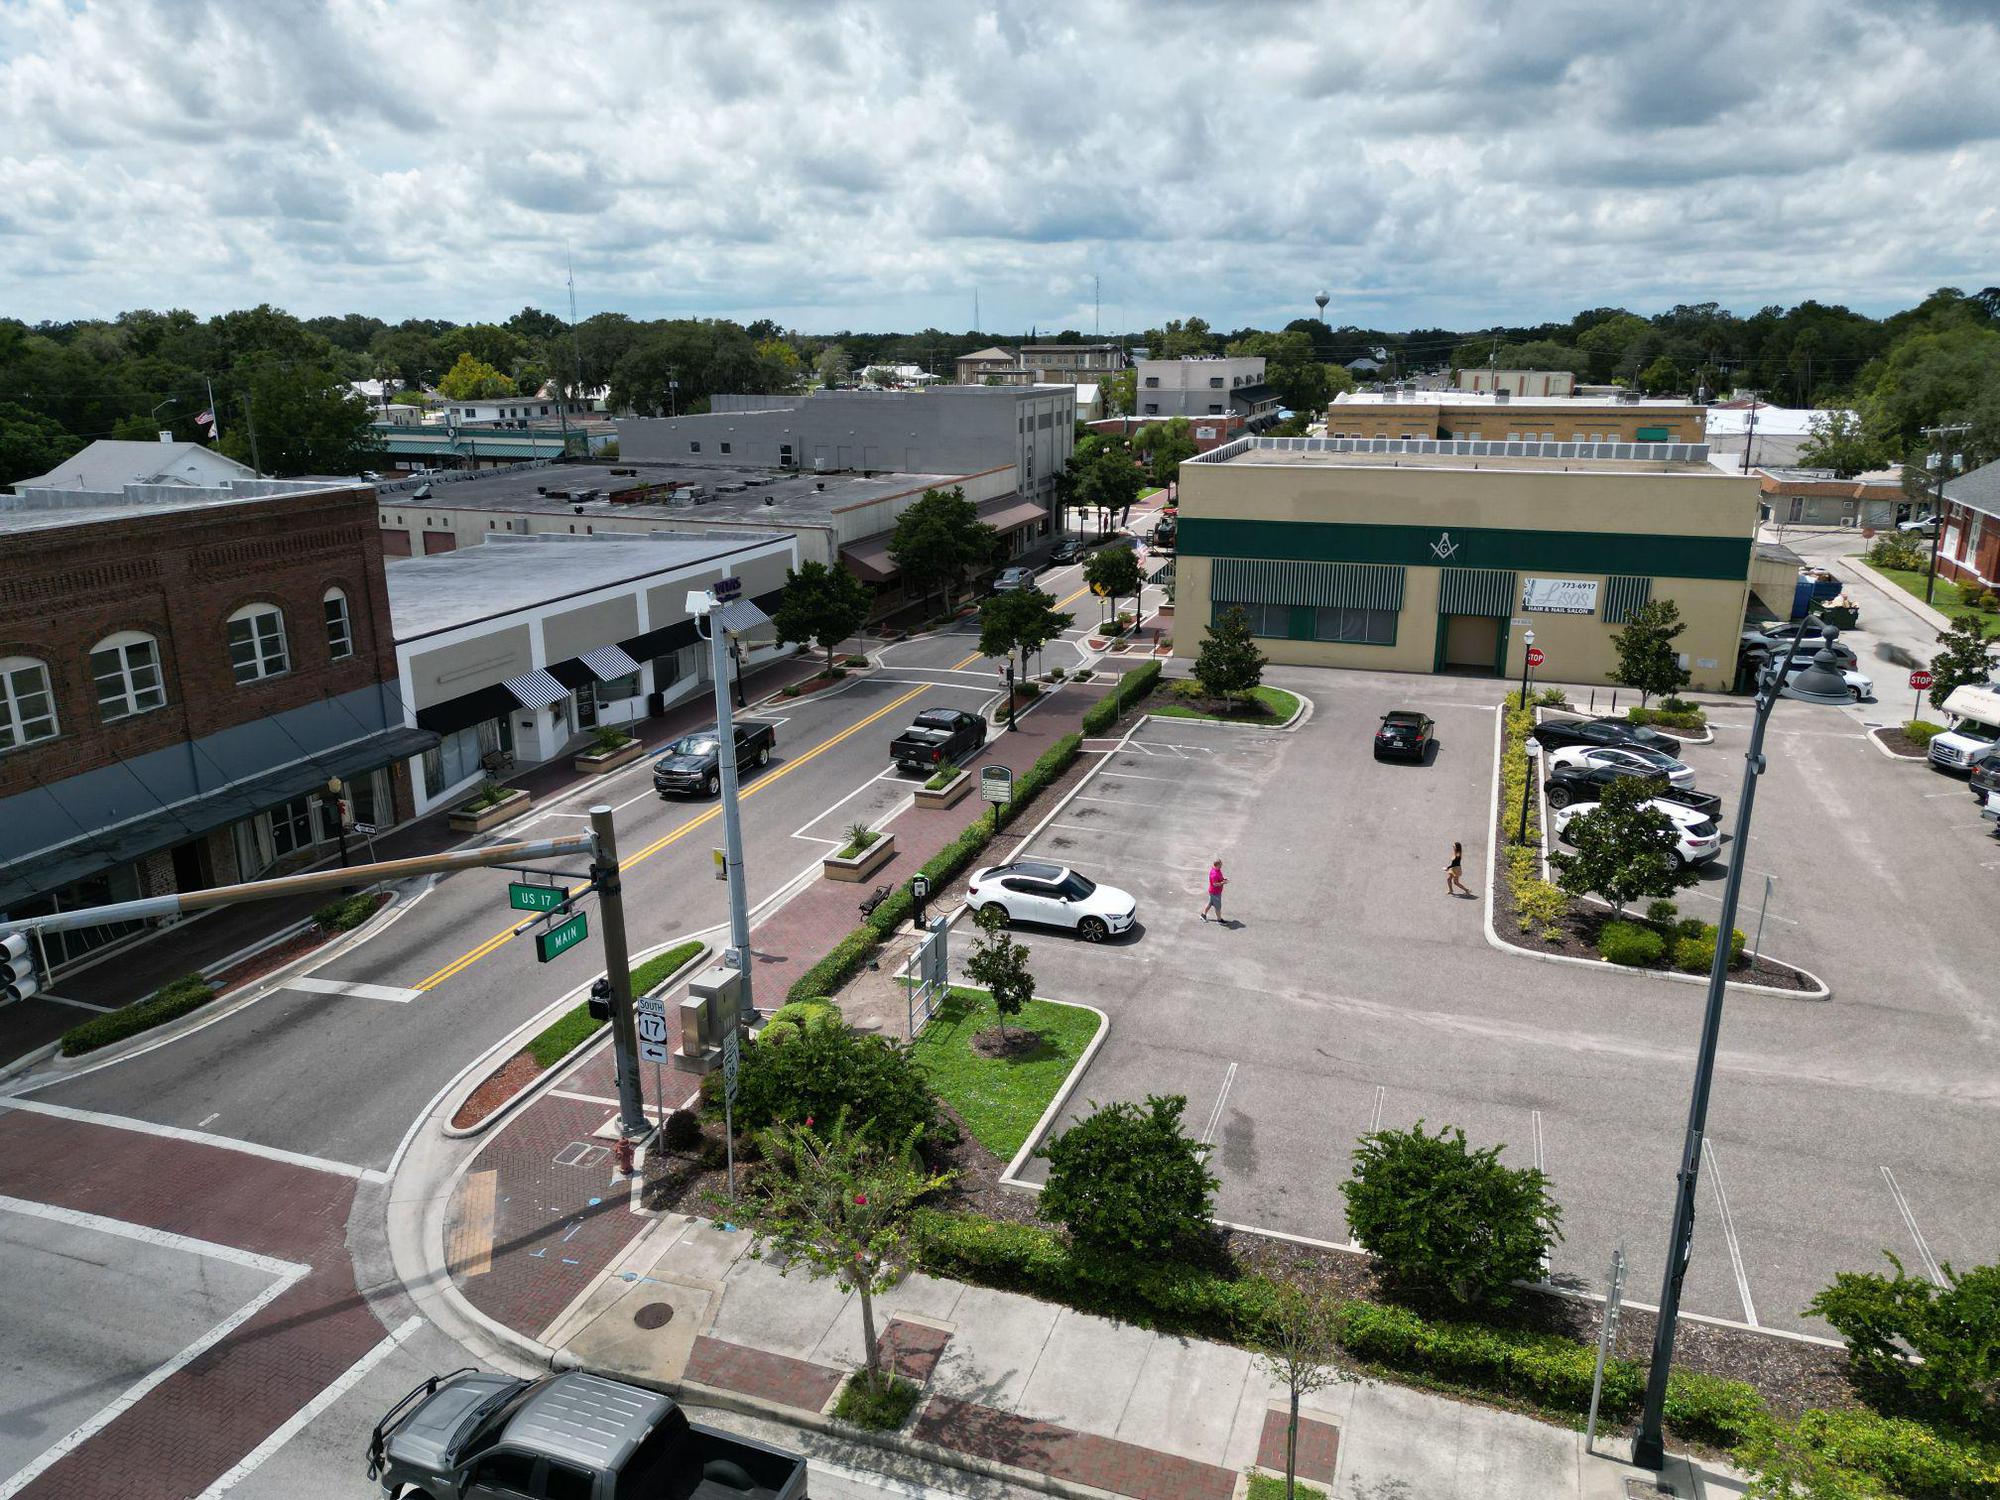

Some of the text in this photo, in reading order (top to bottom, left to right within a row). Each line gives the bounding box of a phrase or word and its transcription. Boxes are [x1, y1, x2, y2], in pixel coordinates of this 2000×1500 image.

[1561, 582, 1596, 590] 773-6917
[1910, 676, 1932, 685] STOP
[521, 892, 552, 906] US 17
[555, 926, 577, 949] MAIN
[640, 1000, 663, 1012] SOUTH
[644, 1020, 660, 1037] 17
